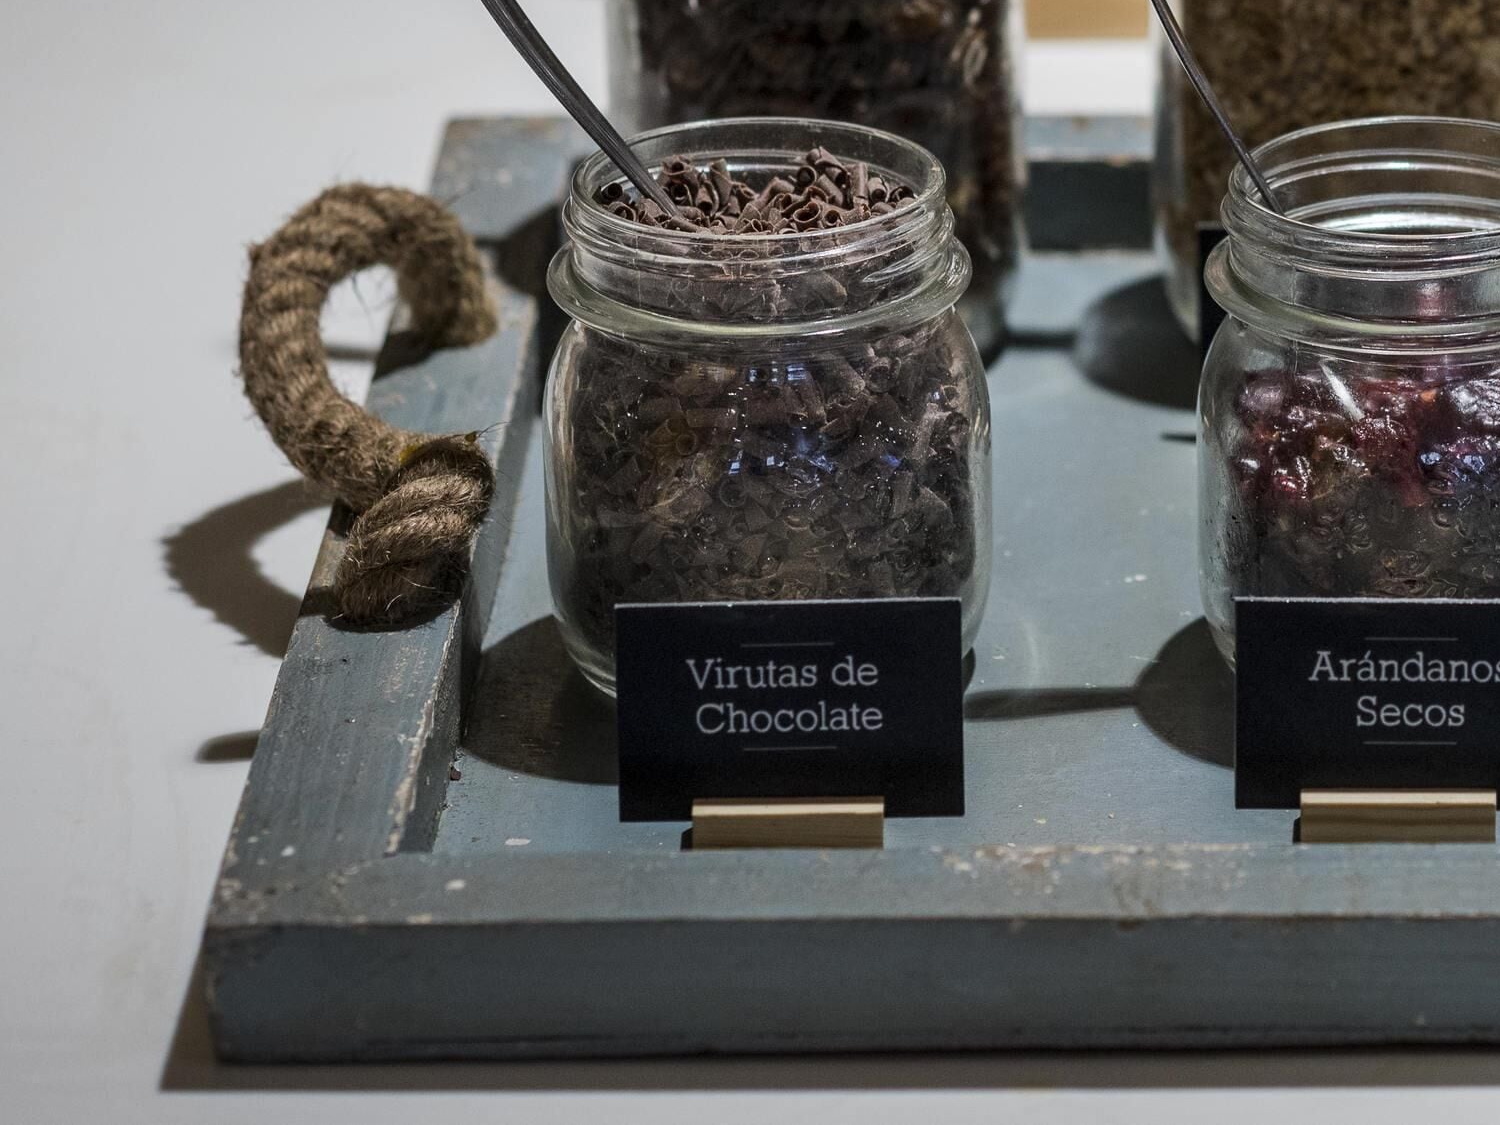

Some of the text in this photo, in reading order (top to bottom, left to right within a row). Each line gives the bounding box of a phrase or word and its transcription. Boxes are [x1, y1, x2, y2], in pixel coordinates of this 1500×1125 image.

[685, 655, 879, 690] Virutas de
[695, 700, 884, 734] Chocolate
[1355, 695, 1466, 728] Secos
